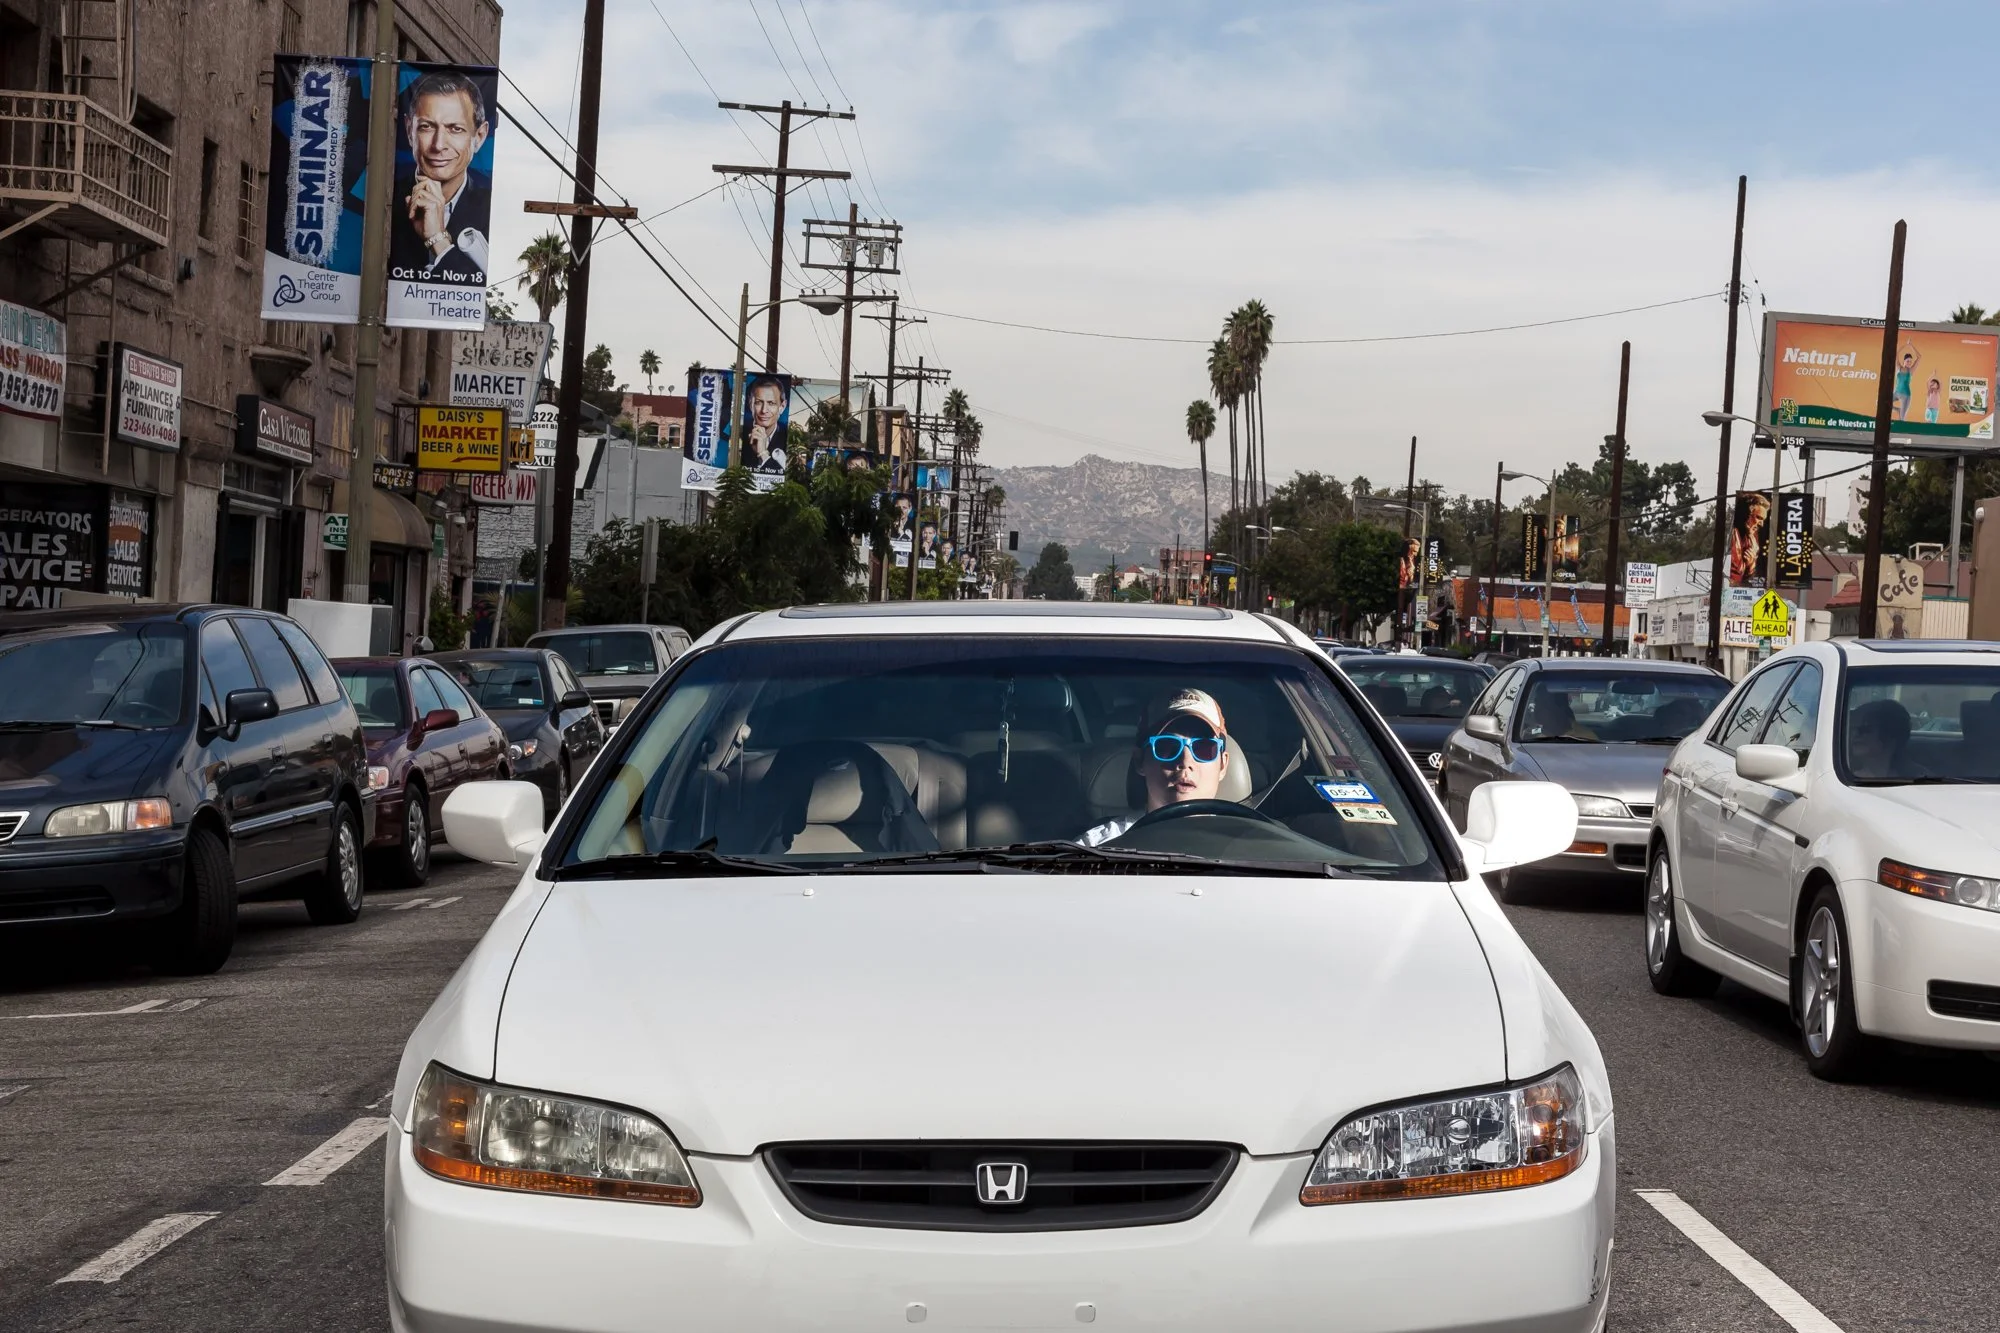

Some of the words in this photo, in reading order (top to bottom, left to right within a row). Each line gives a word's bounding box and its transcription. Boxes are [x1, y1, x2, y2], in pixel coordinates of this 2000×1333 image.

[330, 126, 338, 167] COMEDY
[295, 71, 332, 257] SEMINAR
[328, 168, 336, 193] NEW
[328, 195, 335, 203] A
[307, 270, 339, 282] Center
[393, 267, 414, 279] Oct
[417, 271, 431, 280] 10
[443, 270, 467, 282] Nov
[471, 272, 483, 283] 18
[297, 279, 334, 290] Theatre
[404, 284, 481, 302] Ahmanson
[311, 290, 341, 303] Group
[428, 302, 481, 319] Theatre
[0, 304, 18, 343] AN
[1783, 347, 1857, 367] Natural
[139, 361, 160, 380] TORITO
[161, 368, 176, 384] SHOP
[1795, 366, 1826, 377] como
[1827, 367, 1839, 378] tu
[1842, 369, 1877, 380] cariño
[122, 379, 173, 408] APPLIANCES
[454, 374, 526, 396] MARKET
[125, 398, 174, 425] FURNITURE
[453, 396, 494, 407] PRODUCTOS
[496, 398, 525, 409] LATINOS
[437, 410, 485, 424] DAISY'S
[697, 375, 716, 460] SEMINAR
[1799, 416, 1807, 425] El
[1827, 418, 1837, 427] de
[1838, 419, 1867, 429] Nuestra
[260, 408, 279, 437] Casa
[280, 414, 311, 449] Victoria
[421, 425, 499, 441] MARKET
[421, 441, 453, 453] BEER
[457, 443, 465, 454] &
[468, 444, 499, 455] WINE
[510, 440, 532, 460] KET
[373, 473, 407, 487] TIQUES
[473, 474, 507, 500] BEER
[325, 515, 348, 526] AT
[114, 539, 140, 563] SALES
[107, 563, 142, 587] SERVICE
[1880, 569, 1918, 602] Cafe
[1755, 623, 1785, 633] AHEAD
[1342, 808, 1355, 818] 6
[1376, 810, 1390, 819] 12
